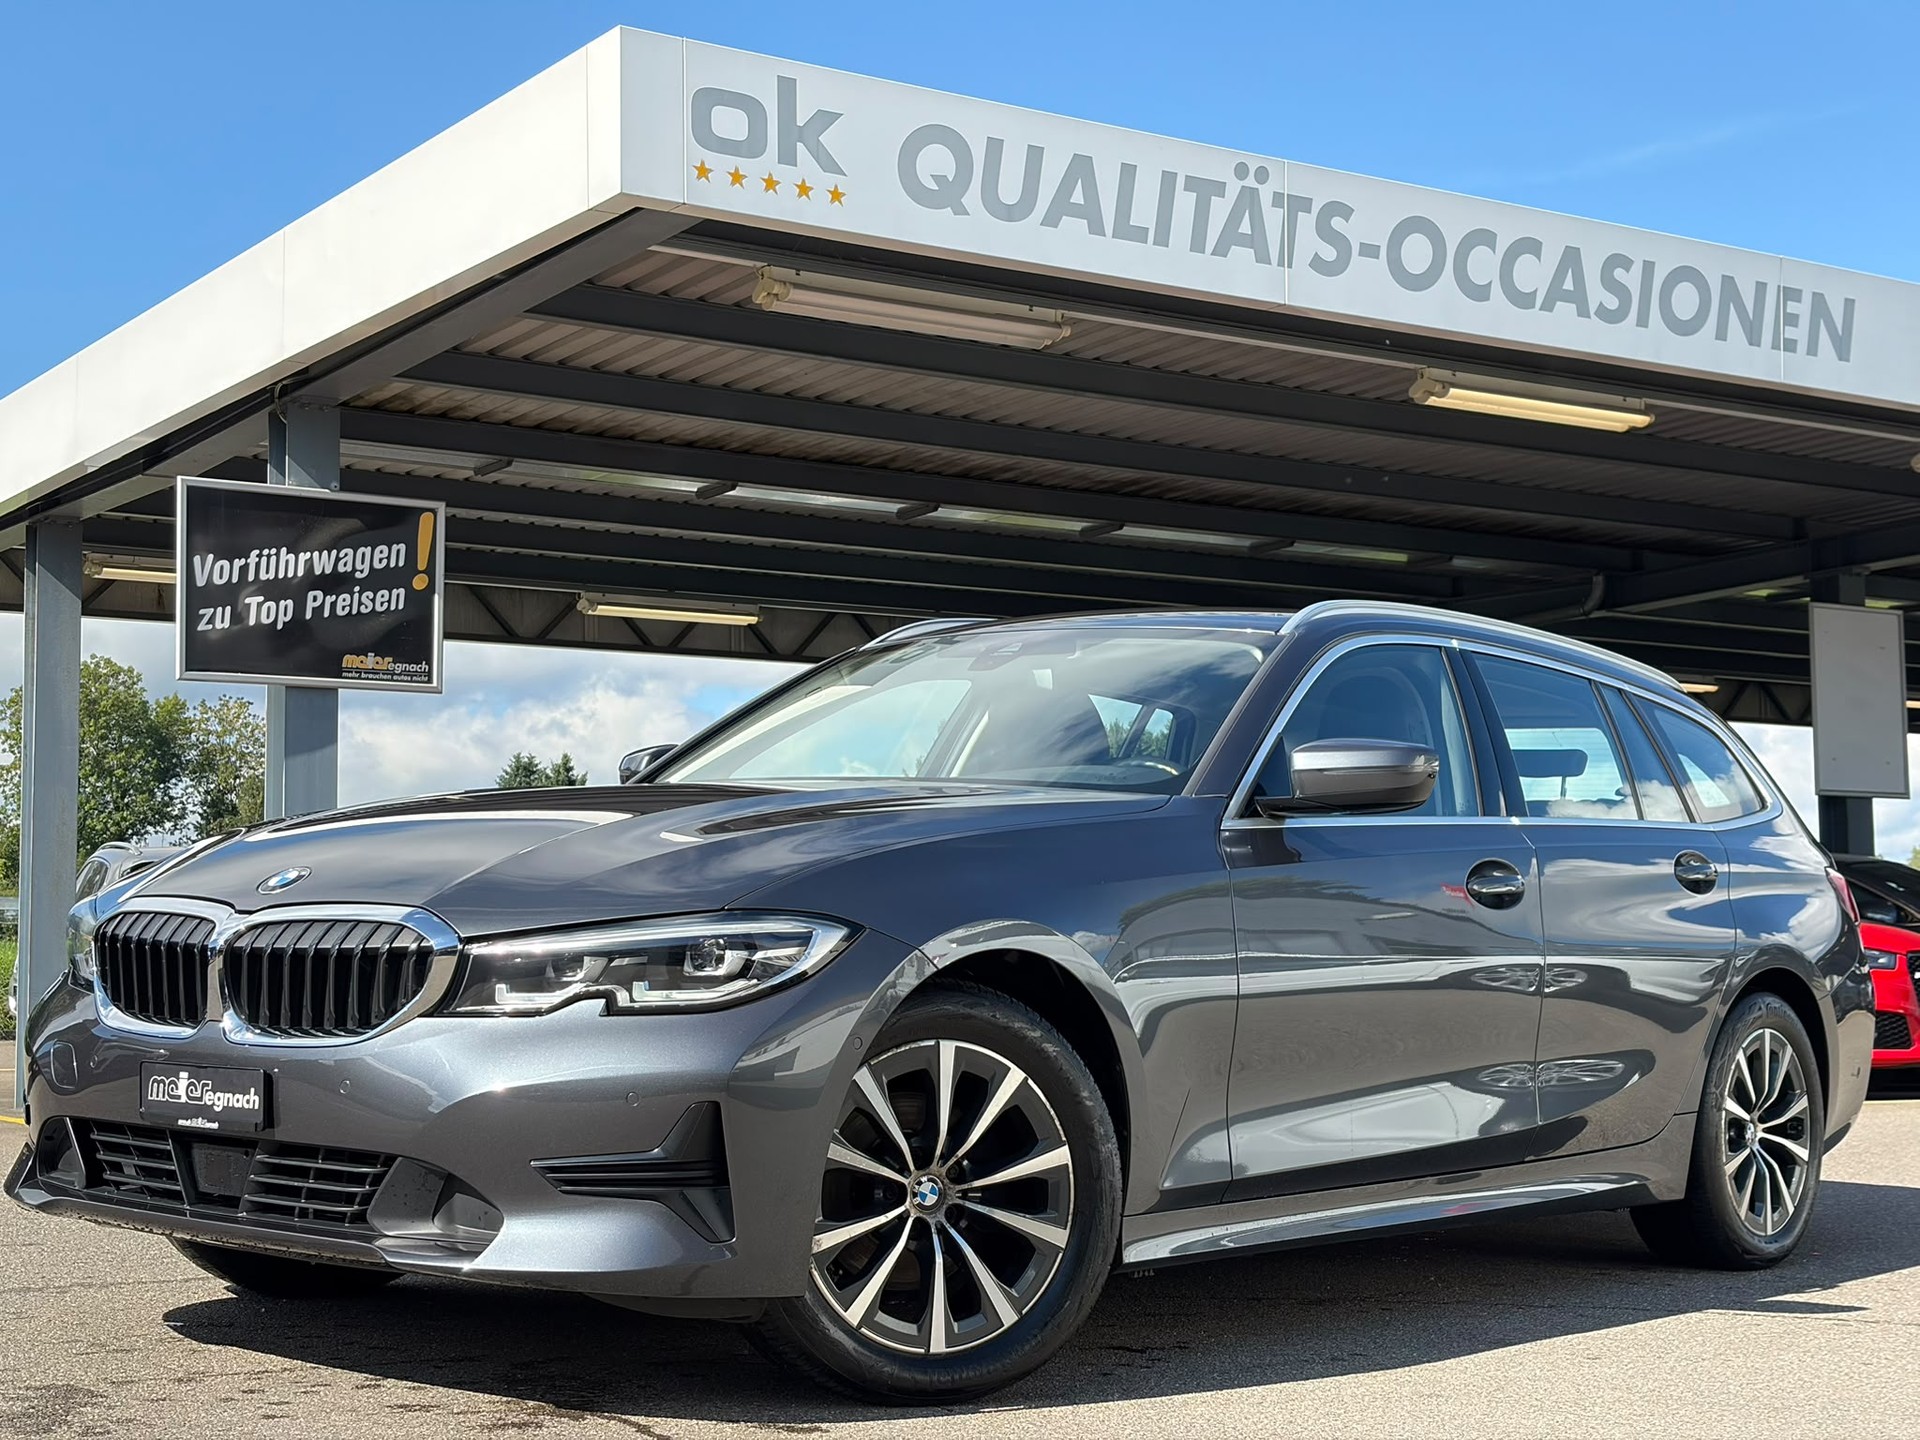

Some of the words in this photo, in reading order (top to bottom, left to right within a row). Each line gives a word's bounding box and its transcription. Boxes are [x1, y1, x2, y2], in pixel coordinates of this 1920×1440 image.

[690, 74, 848, 178] ok
[897, 123, 1856, 364] QUALITÄTS-OCCASIONEN
[192, 542, 407, 588] Vorführwagen
[196, 604, 232, 632] zu
[243, 595, 295, 631] Top
[304, 585, 406, 621] Preisen
[361, 671, 391, 680] brauchen
